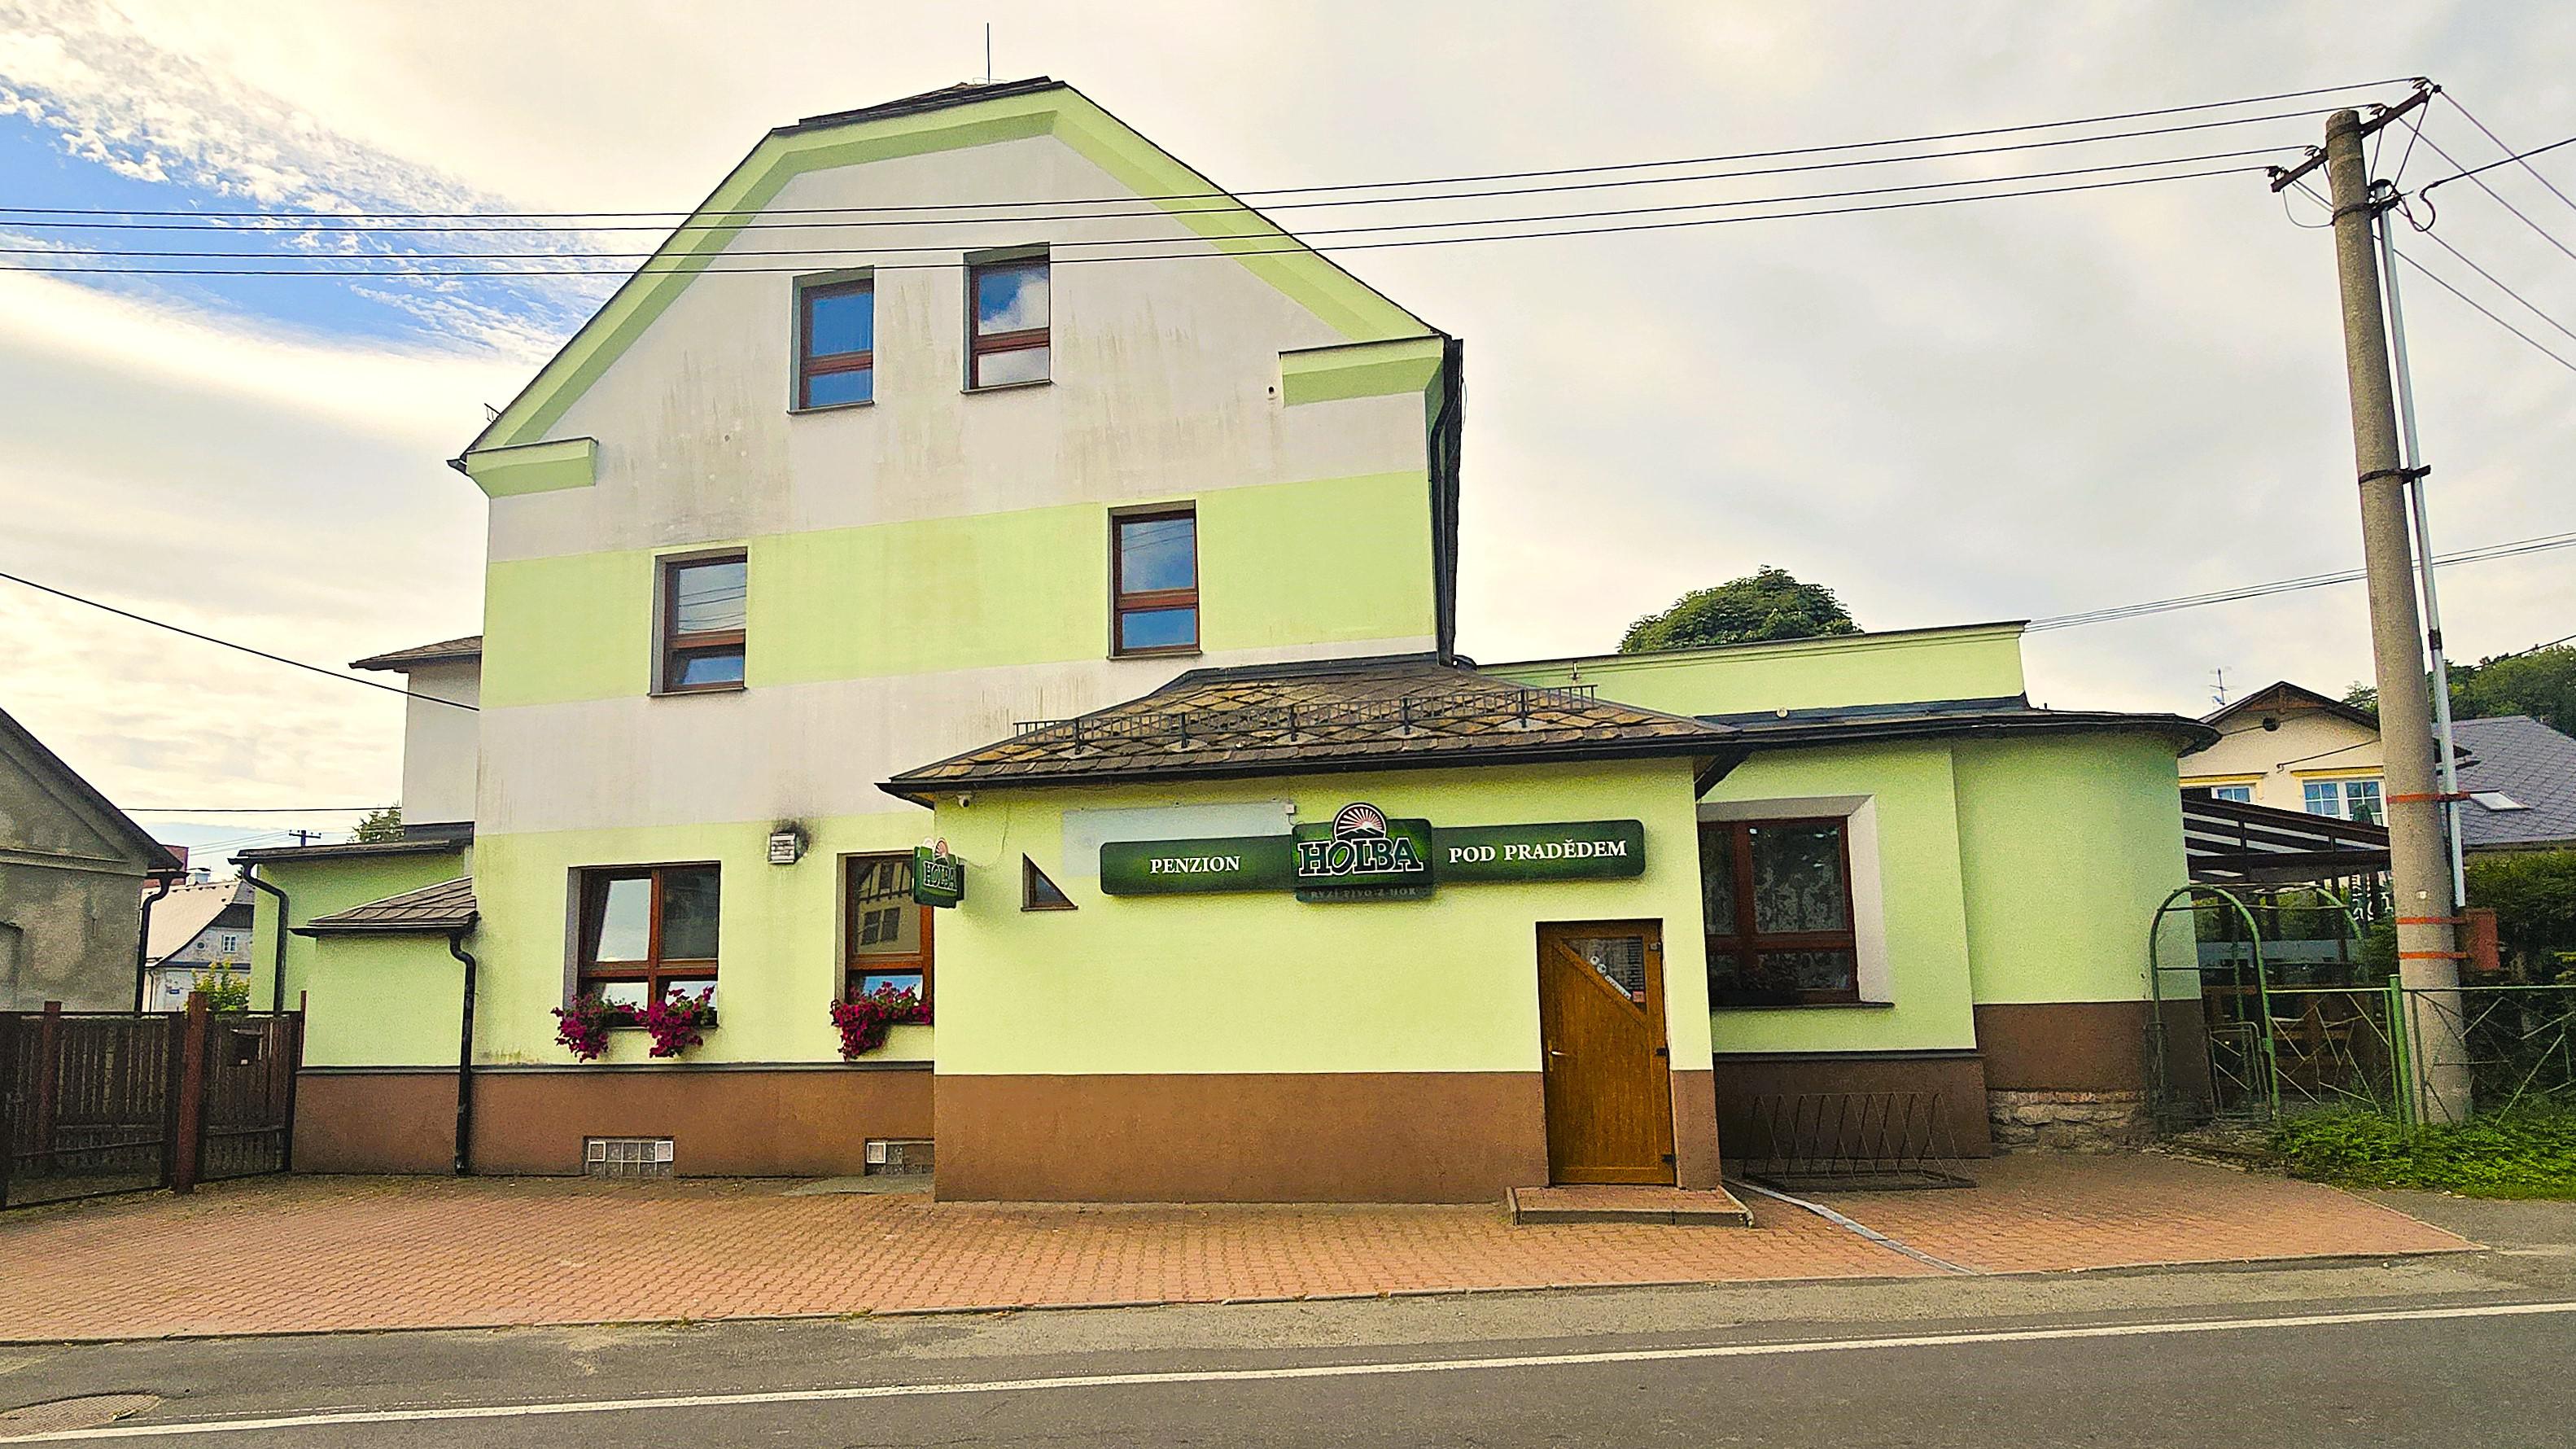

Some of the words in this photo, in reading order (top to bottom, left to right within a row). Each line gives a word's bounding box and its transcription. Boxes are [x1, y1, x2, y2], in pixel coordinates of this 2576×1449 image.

[1149, 856, 1240, 873] PENZION
[1298, 837, 1424, 877] HOLBA
[1449, 846, 1496, 863] POD
[1503, 838, 1627, 860] PRADĚDEM
[924, 860, 957, 891] HOLBA
